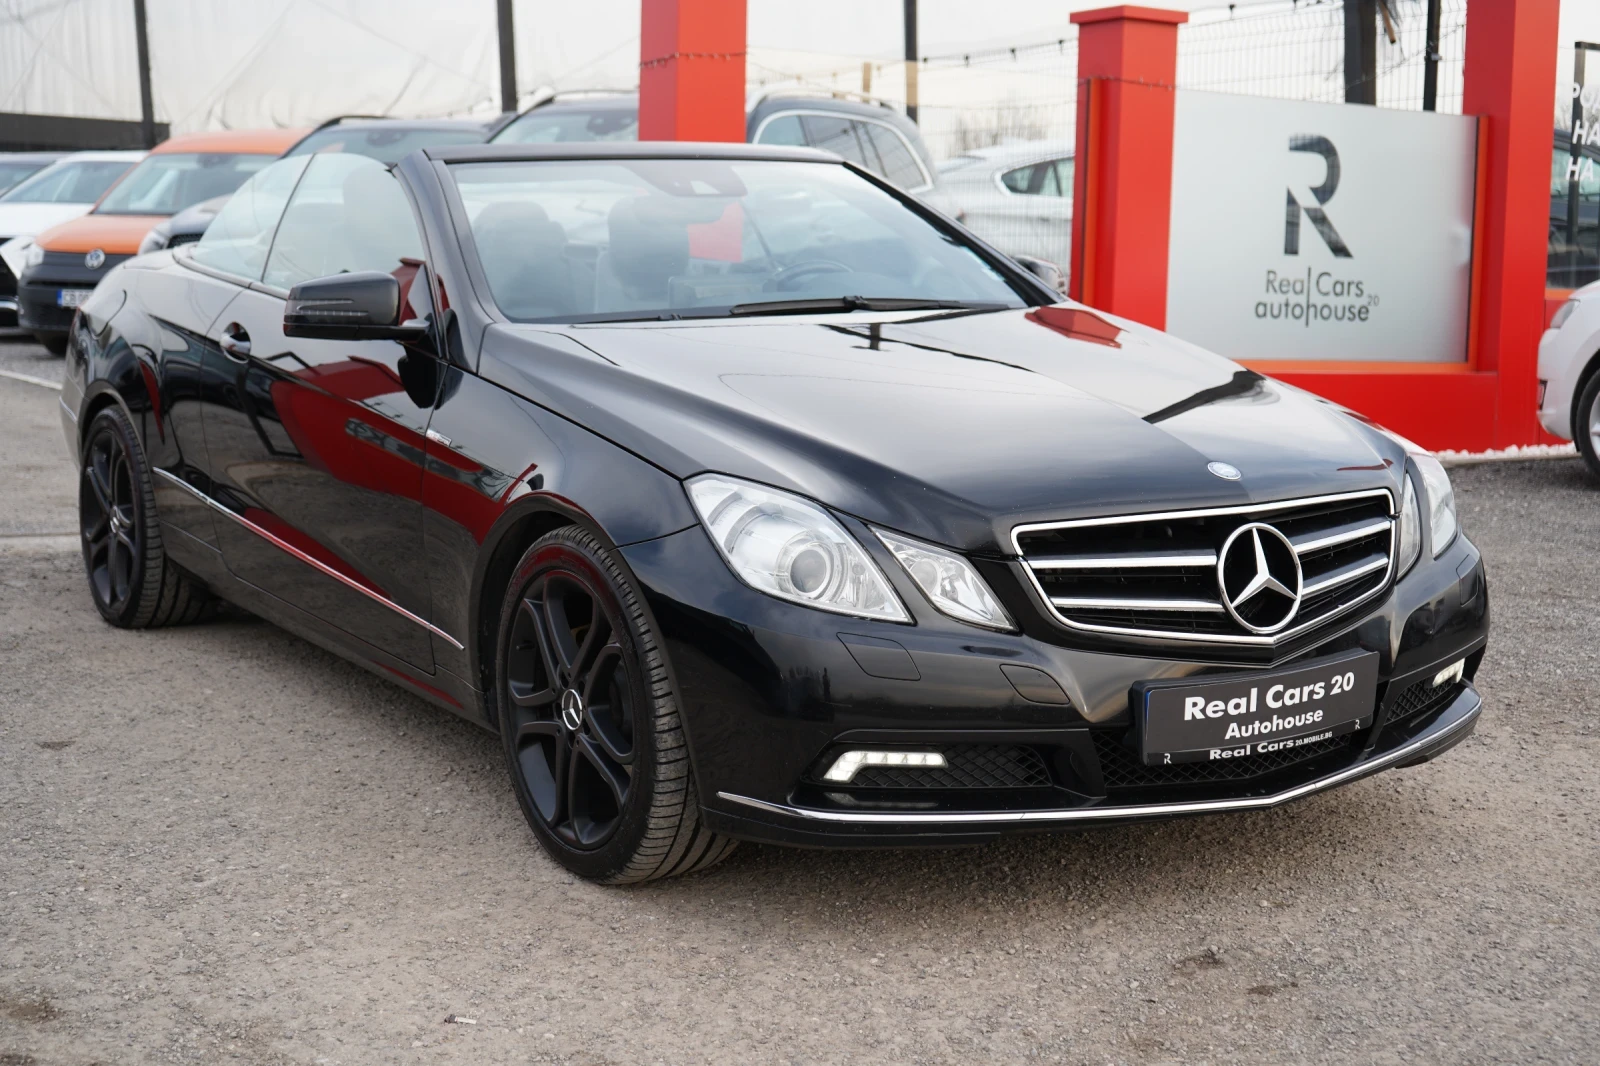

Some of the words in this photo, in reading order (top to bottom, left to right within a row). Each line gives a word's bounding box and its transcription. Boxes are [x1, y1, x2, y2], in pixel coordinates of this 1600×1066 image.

[1284, 134, 1354, 258] R
[1316, 271, 1364, 298] Cars
[1366, 293, 1380, 307] 20
[1255, 297, 1370, 323] autohouse
[1184, 687, 1258, 721] Real
[1265, 683, 1325, 709] Cars
[1330, 672, 1355, 696] 20
[1224, 709, 1324, 740] Autohouse
[1209, 745, 1251, 760] Real
[1257, 740, 1294, 753] Cars
